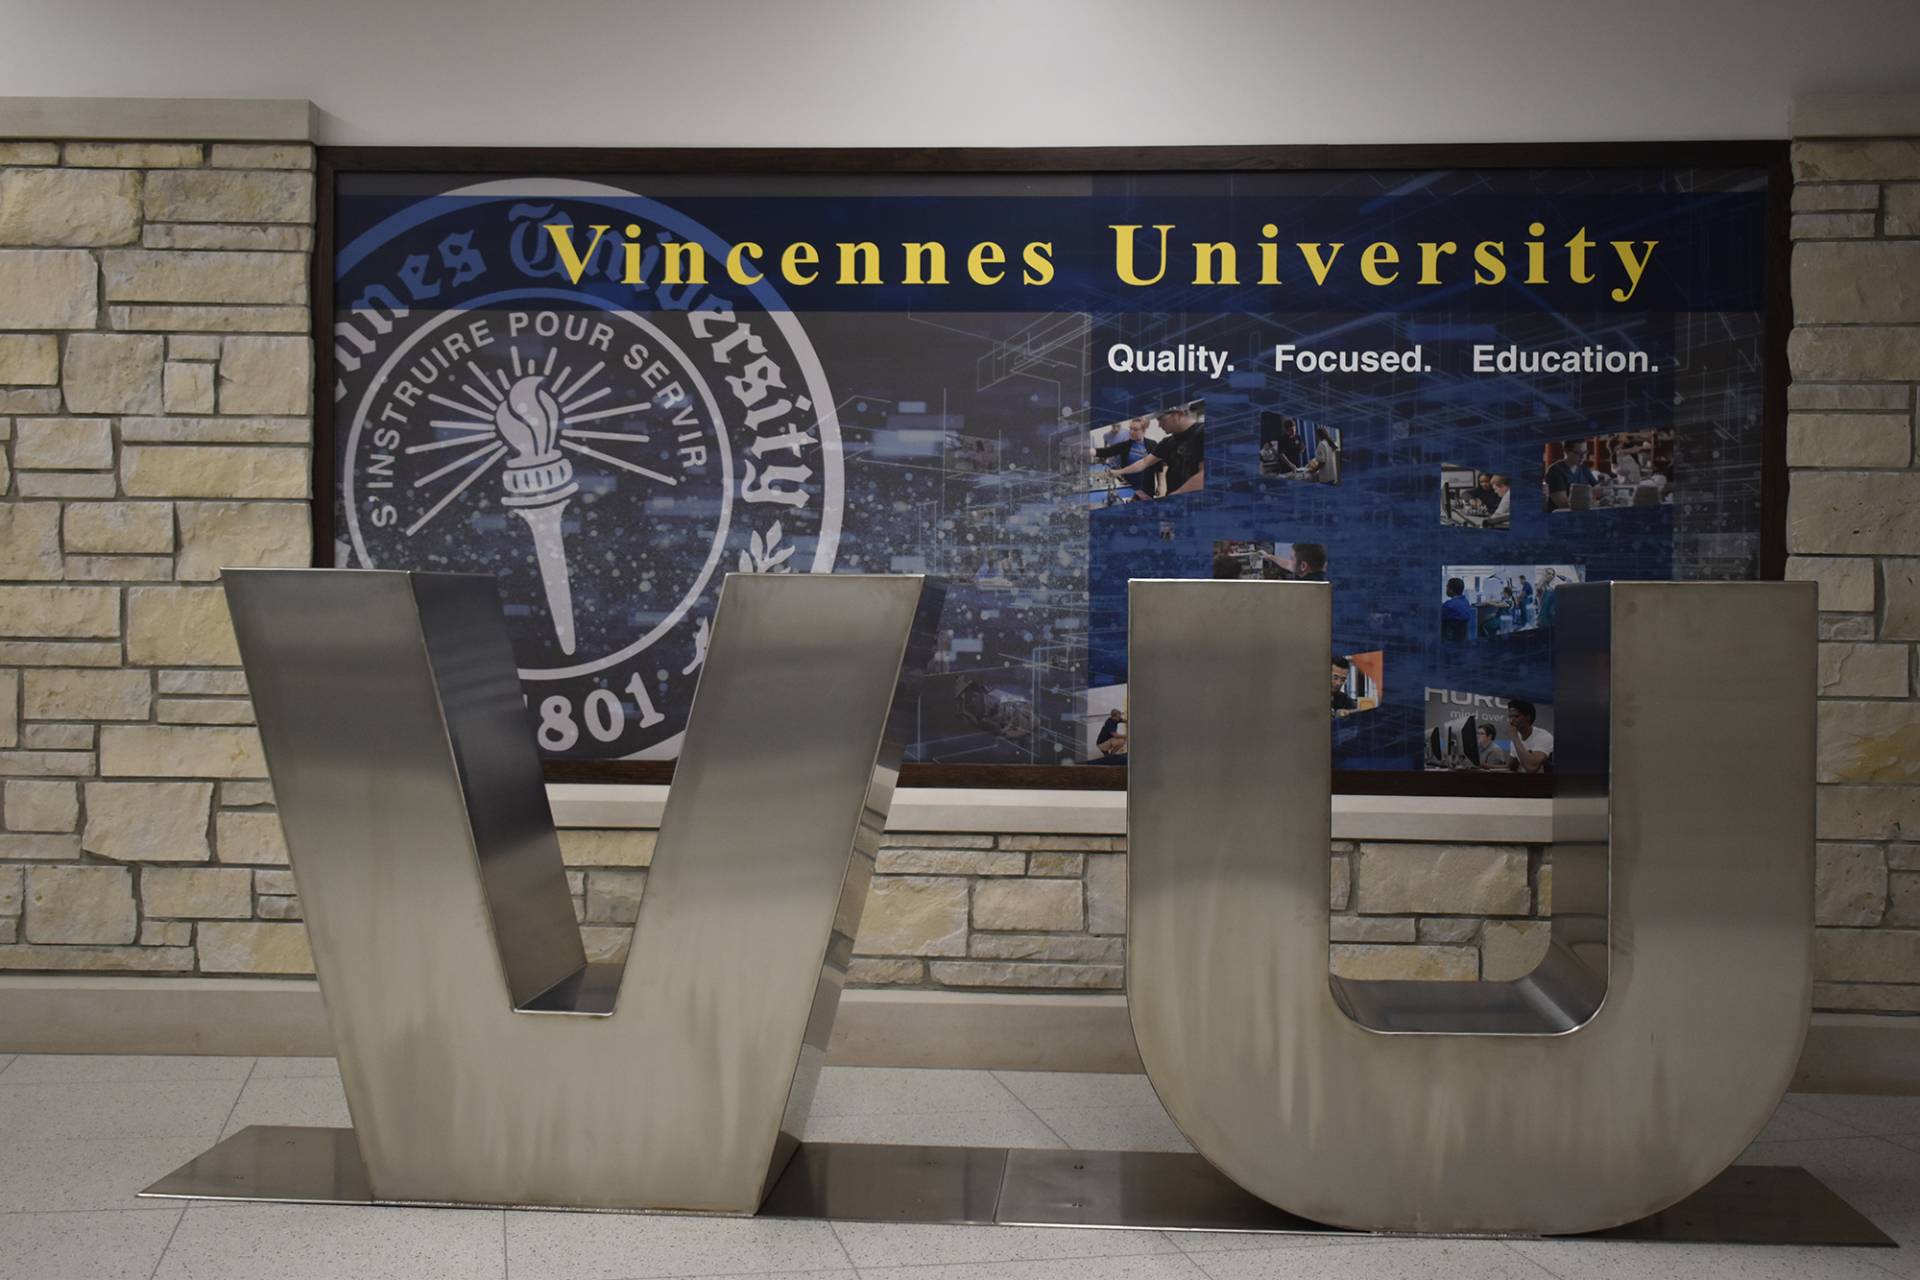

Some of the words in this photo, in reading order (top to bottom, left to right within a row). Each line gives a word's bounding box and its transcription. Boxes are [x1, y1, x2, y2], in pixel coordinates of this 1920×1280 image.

[543, 222, 1057, 288] Vincennes
[1109, 222, 1659, 304] University
[508, 310, 616, 352] POUR
[622, 343, 708, 468] SERVIR
[1107, 343, 1236, 380] Quality.
[1274, 343, 1433, 374] Focused.
[1472, 343, 1659, 374] Education.
[523, 671, 666, 752] 801
[1481, 710, 1505, 722] over
